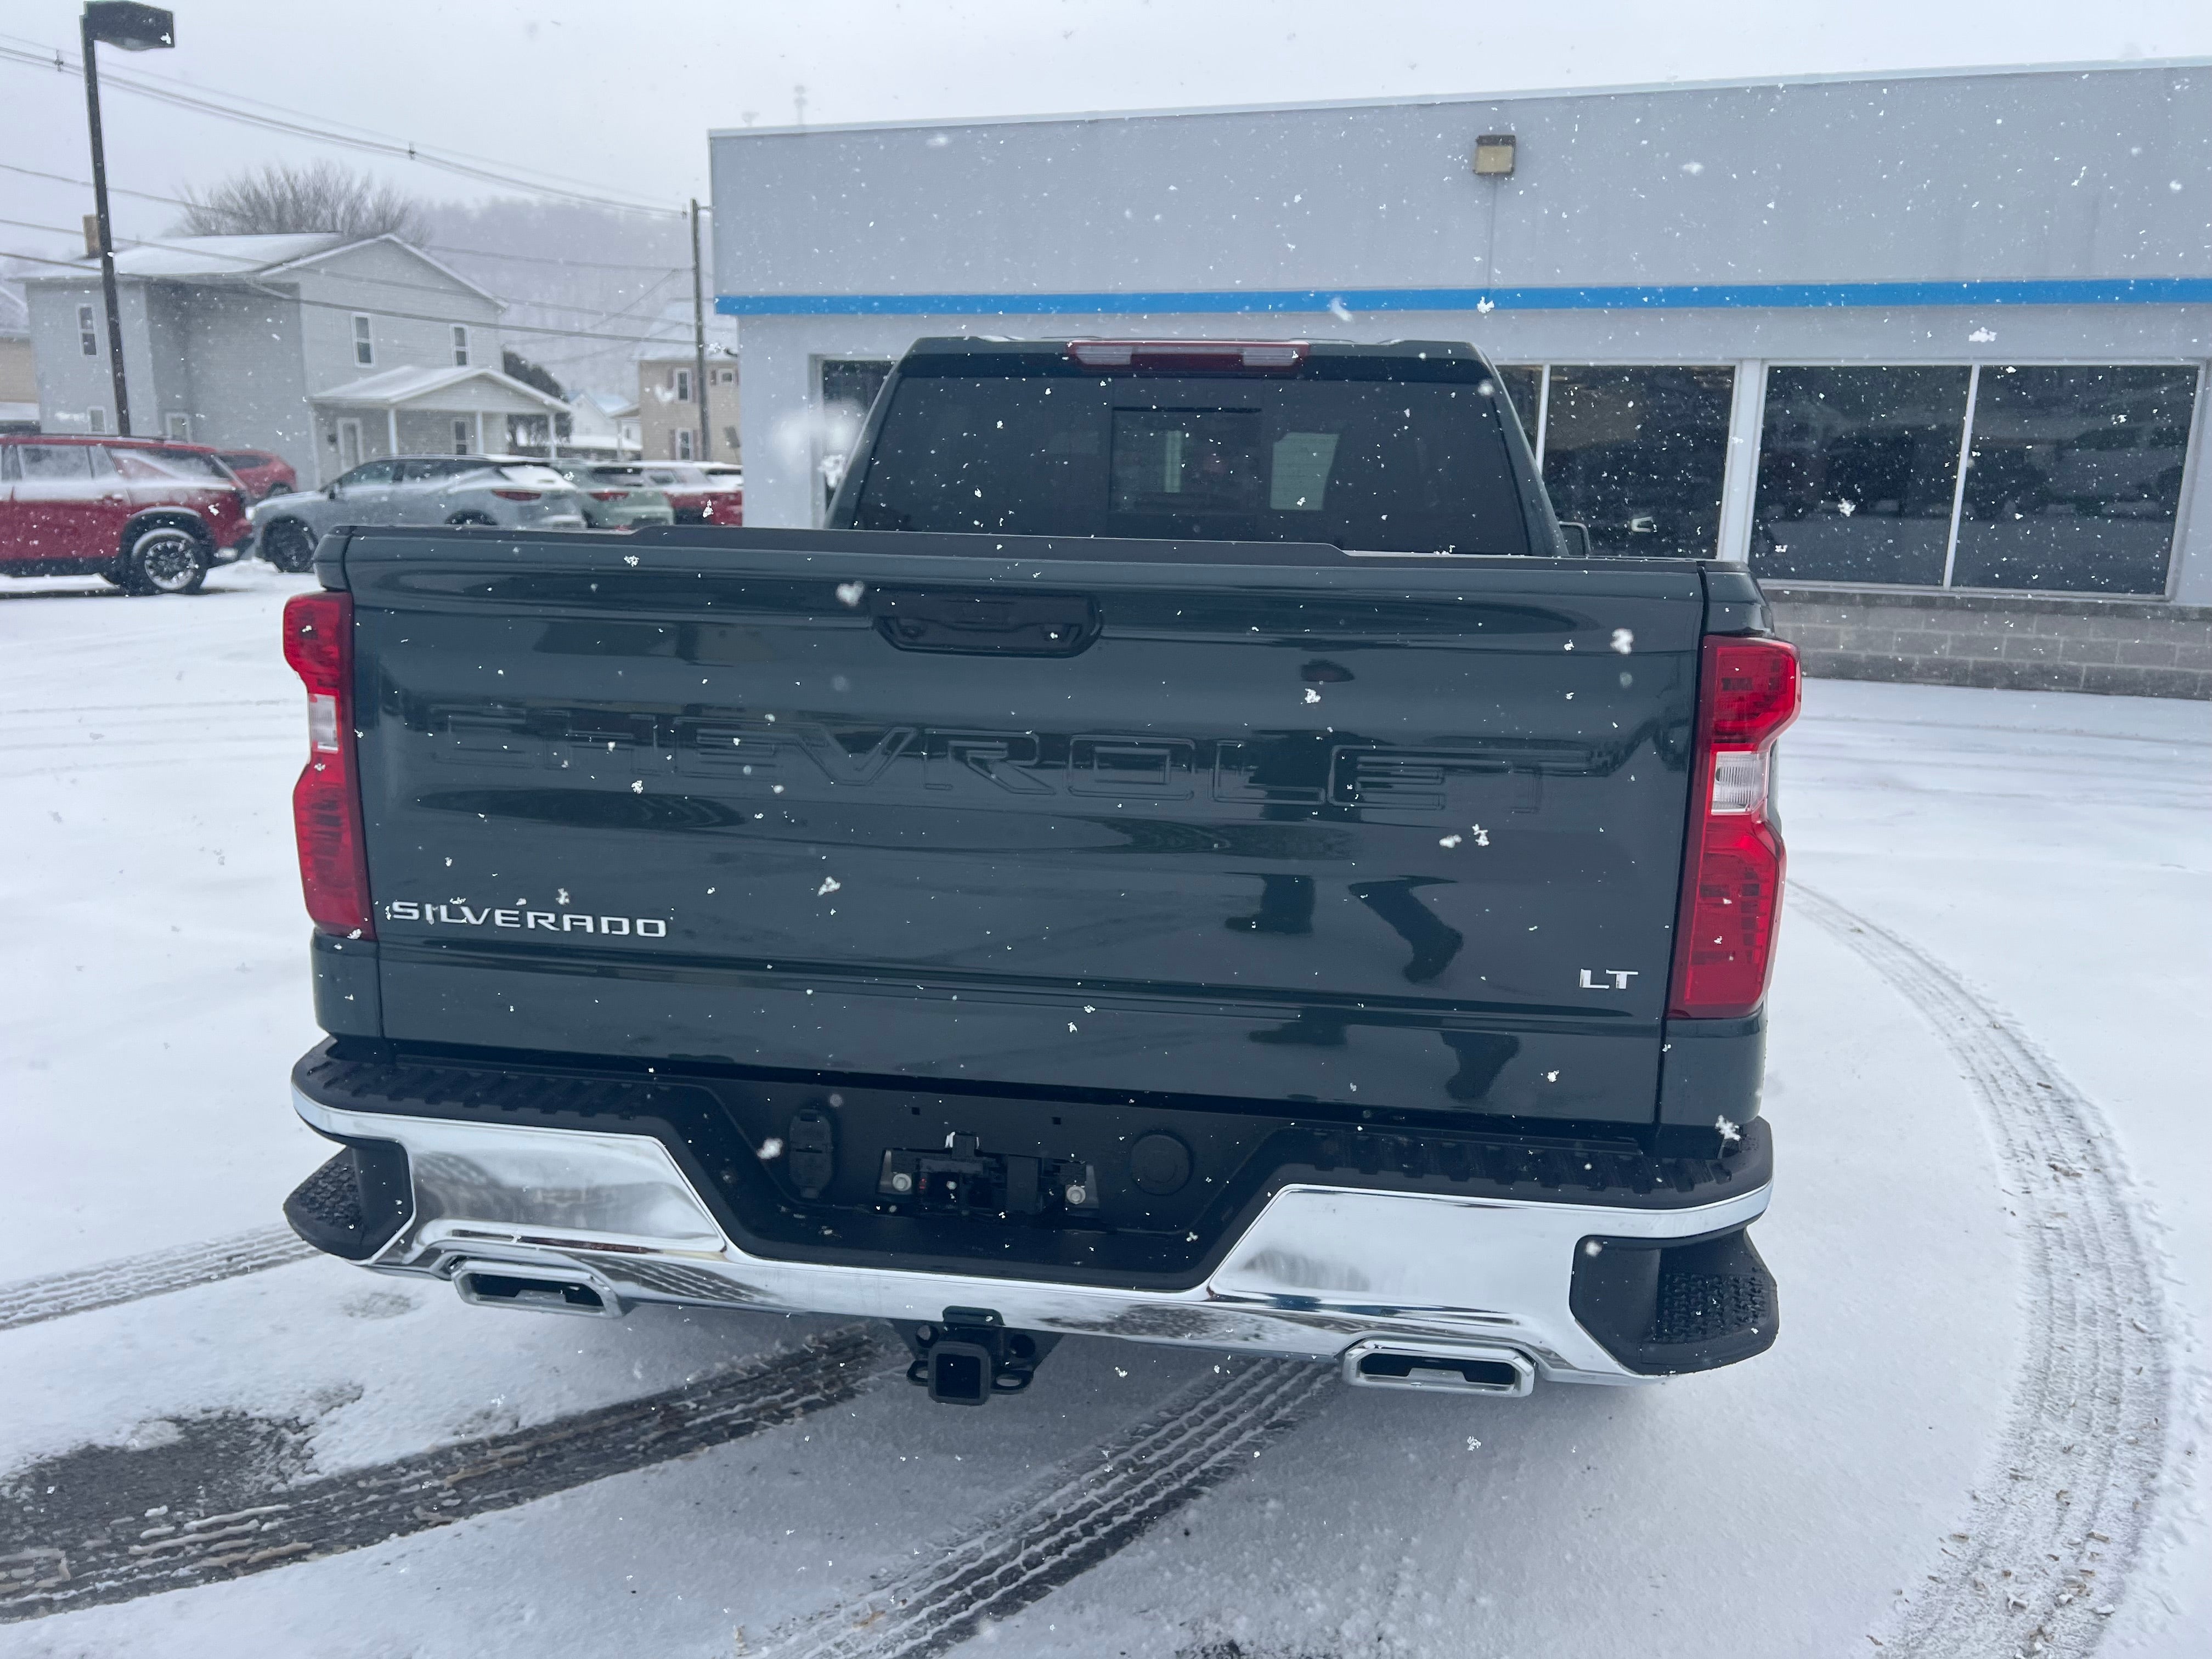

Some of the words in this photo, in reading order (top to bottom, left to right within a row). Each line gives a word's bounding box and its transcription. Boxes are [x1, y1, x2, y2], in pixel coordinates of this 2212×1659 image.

[429, 704, 1598, 814] CHEVROLET
[392, 901, 667, 938] SILVERADO
[1579, 968, 1639, 990] LT
